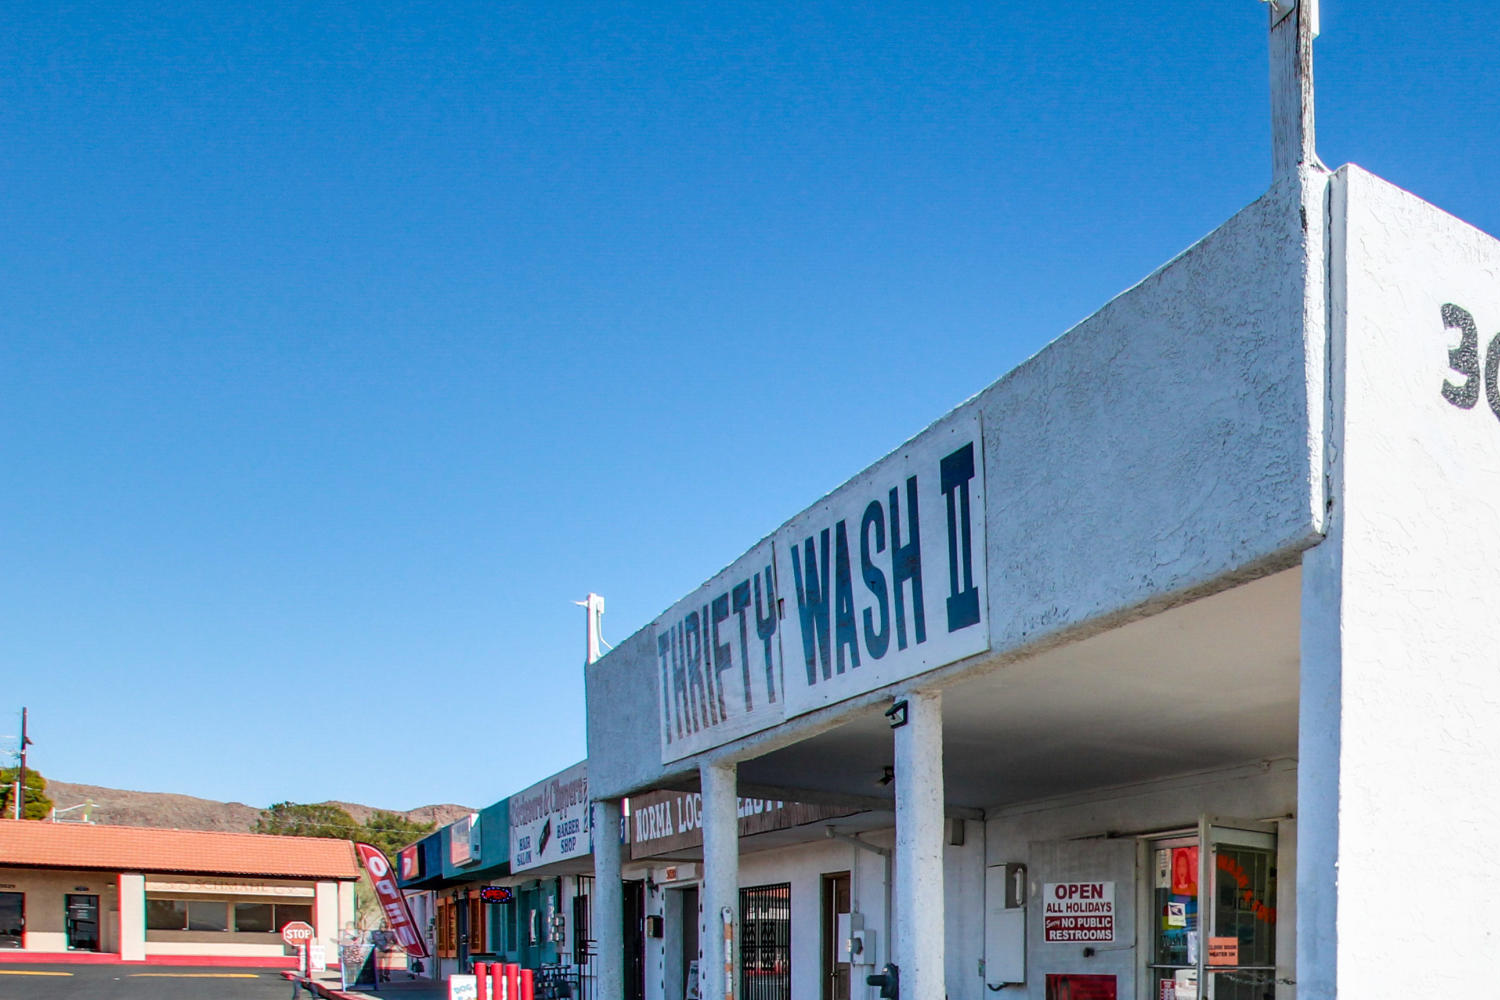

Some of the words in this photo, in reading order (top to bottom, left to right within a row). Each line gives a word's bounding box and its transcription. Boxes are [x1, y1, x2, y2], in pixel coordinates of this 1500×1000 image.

[657, 564, 777, 745] THRIFTY
[790, 474, 927, 686] WASH
[939, 440, 981, 633] II
[557, 818, 580, 839] BARBER
[634, 801, 674, 843] NORMA
[560, 836, 577, 854] SHOP
[1055, 884, 1104, 900] OPEN
[367, 855, 416, 947] OPEN
[1046, 902, 1064, 913] ALL
[1065, 902, 1112, 913] HOLIDAYS
[1061, 918, 1076, 928] NO
[1077, 917, 1112, 928] PUBLIC
[285, 926, 312, 940] STOP
[1049, 929, 1112, 940] RESTROOMS
